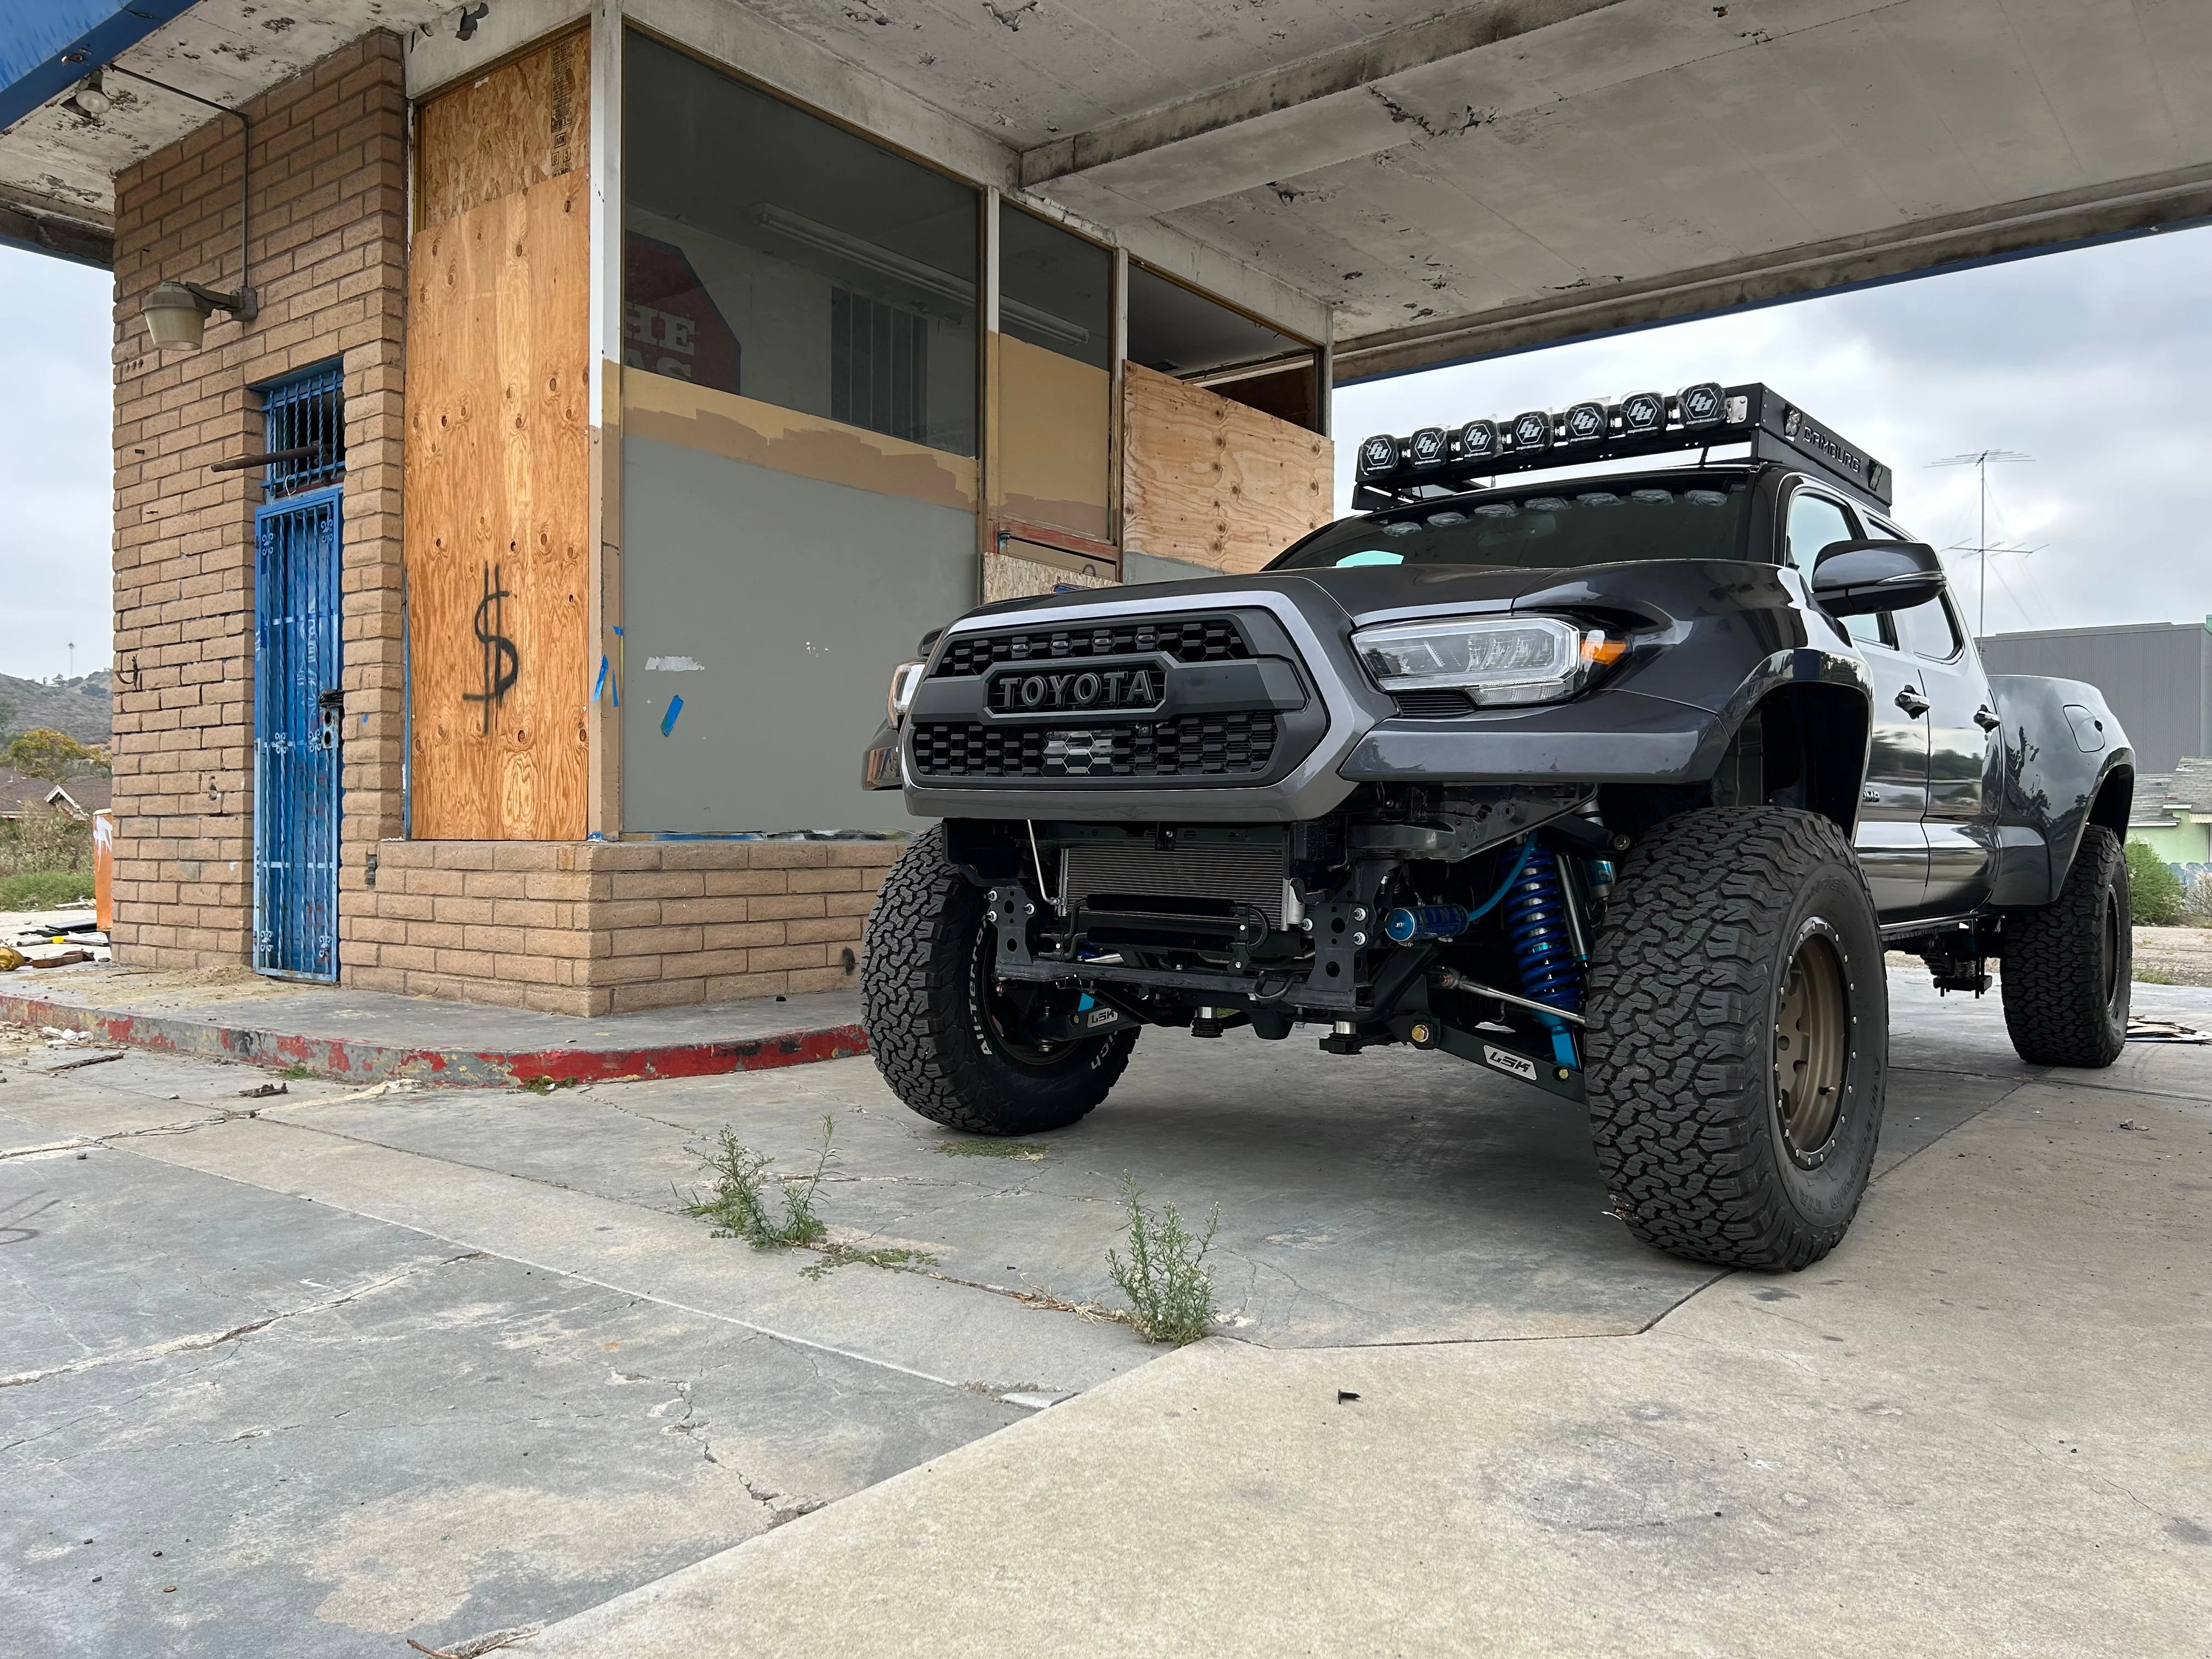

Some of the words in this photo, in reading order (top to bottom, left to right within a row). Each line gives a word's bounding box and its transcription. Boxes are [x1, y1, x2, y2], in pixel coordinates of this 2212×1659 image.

[1803, 425, 1861, 473] CAMBURG
[999, 669, 1156, 709] TOYOTA
[1091, 1010, 1114, 1024] LSK
[1488, 1051, 1531, 1073] LSK
